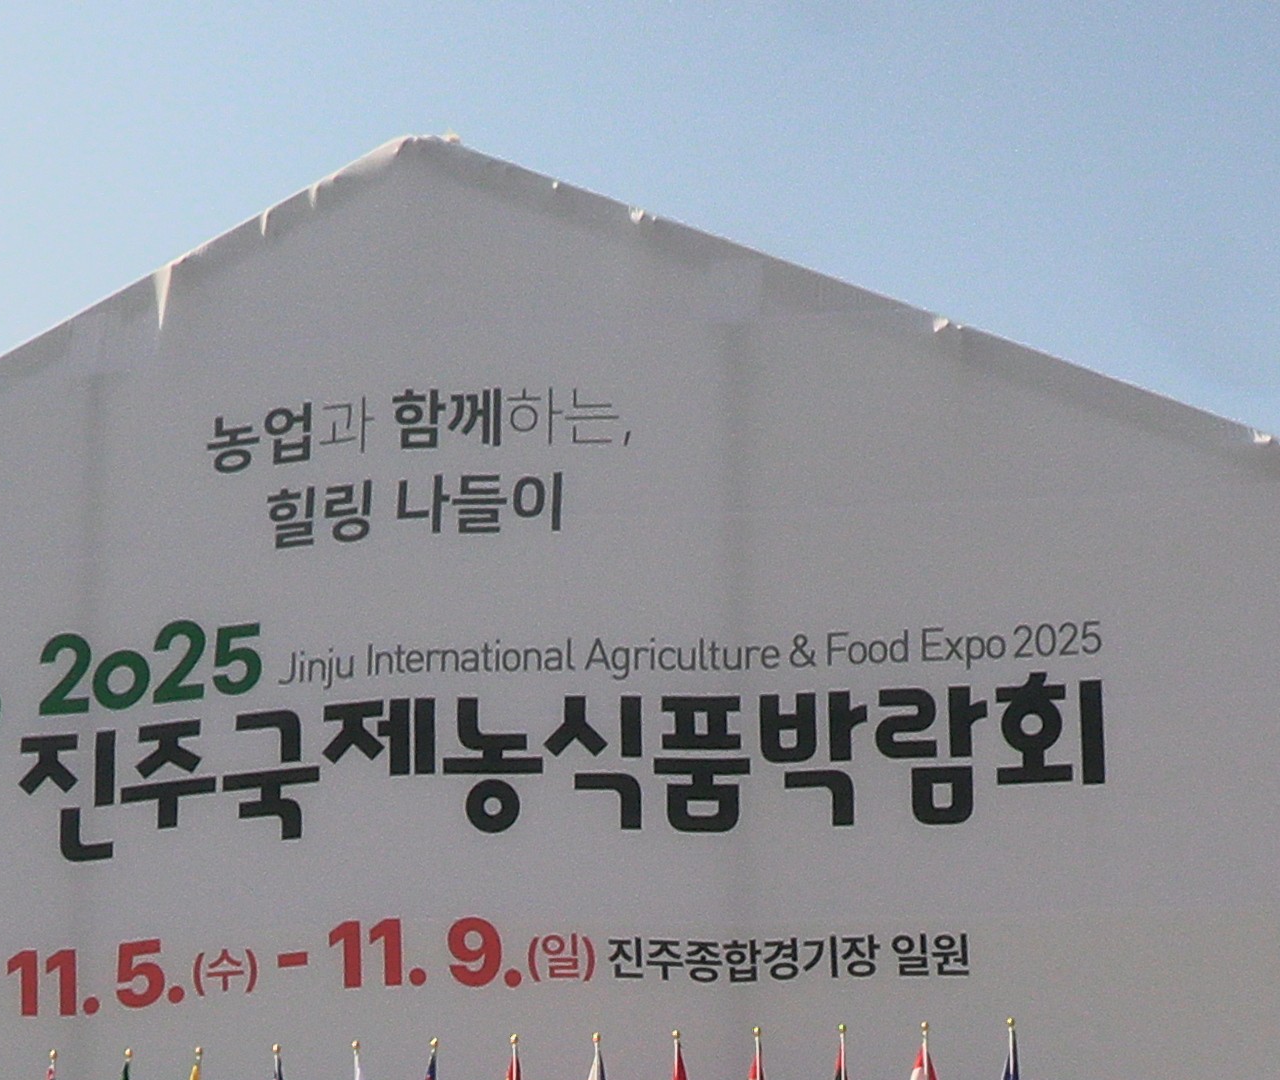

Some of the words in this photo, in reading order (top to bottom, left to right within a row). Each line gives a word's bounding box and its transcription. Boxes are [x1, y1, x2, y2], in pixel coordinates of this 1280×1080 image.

[206, 394, 376, 475] 농업과
[391, 386, 632, 450] 함께하는,
[266, 478, 374, 550] 힐링
[396, 471, 563, 534] 나들이
[38, 619, 263, 717] 2025
[277, 647, 355, 690] Jinju
[366, 637, 576, 677] International
[585, 636, 780, 680] Agriculture
[788, 633, 818, 668] &
[826, 629, 910, 666] Food
[920, 626, 1007, 670] Expo
[1013, 620, 1103, 658] 2025
[18, 671, 1106, 863] 진주국제농식품박람회
[607, 933, 880, 984] 진주종합경기장
[891, 932, 970, 978] 일원
